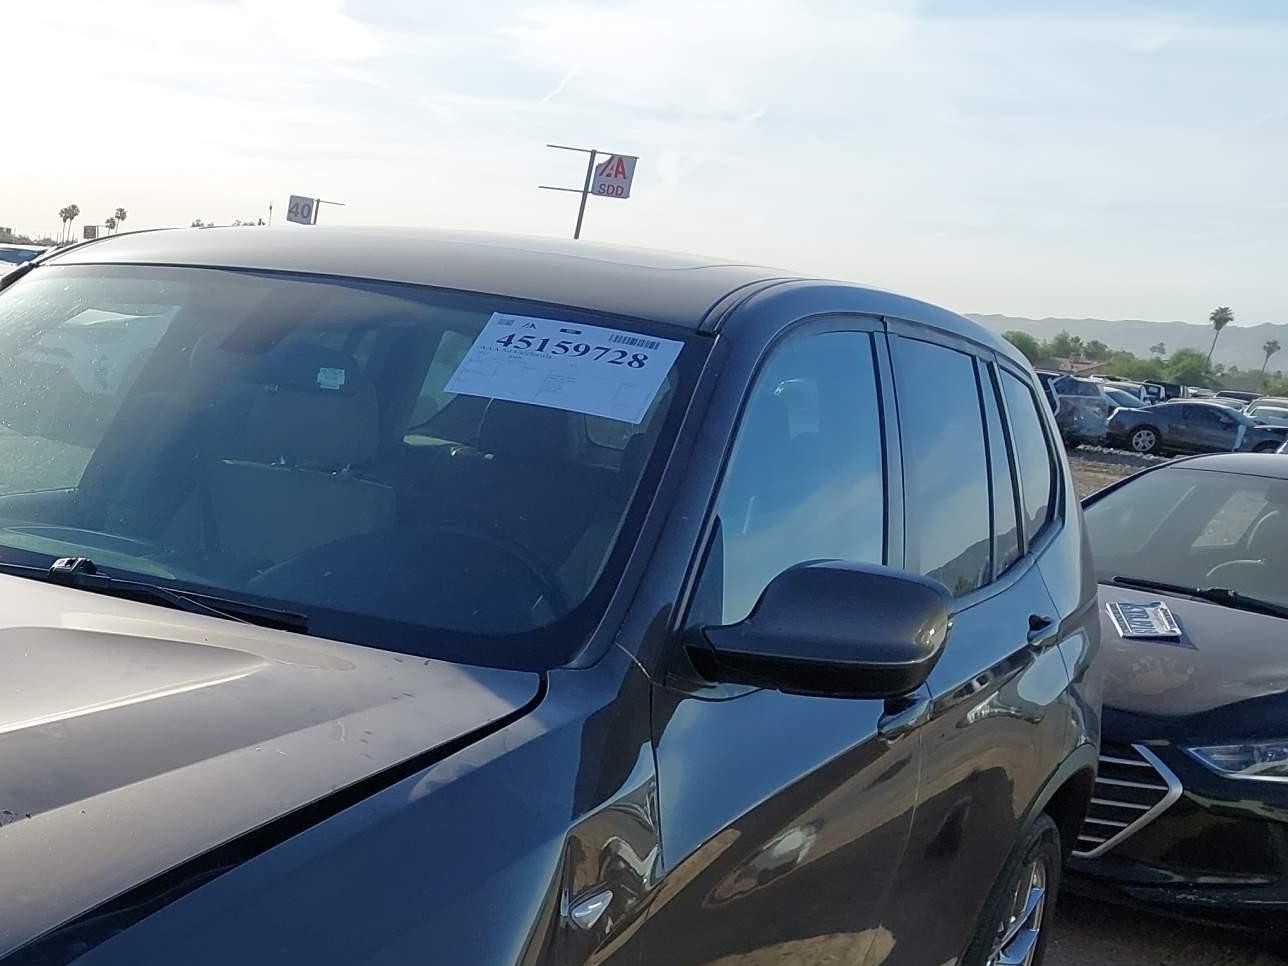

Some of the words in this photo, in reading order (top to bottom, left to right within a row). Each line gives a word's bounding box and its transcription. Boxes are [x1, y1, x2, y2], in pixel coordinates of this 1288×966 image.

[598, 183, 624, 196] SDD
[289, 202, 312, 219] 40
[496, 332, 649, 369] 45159728
